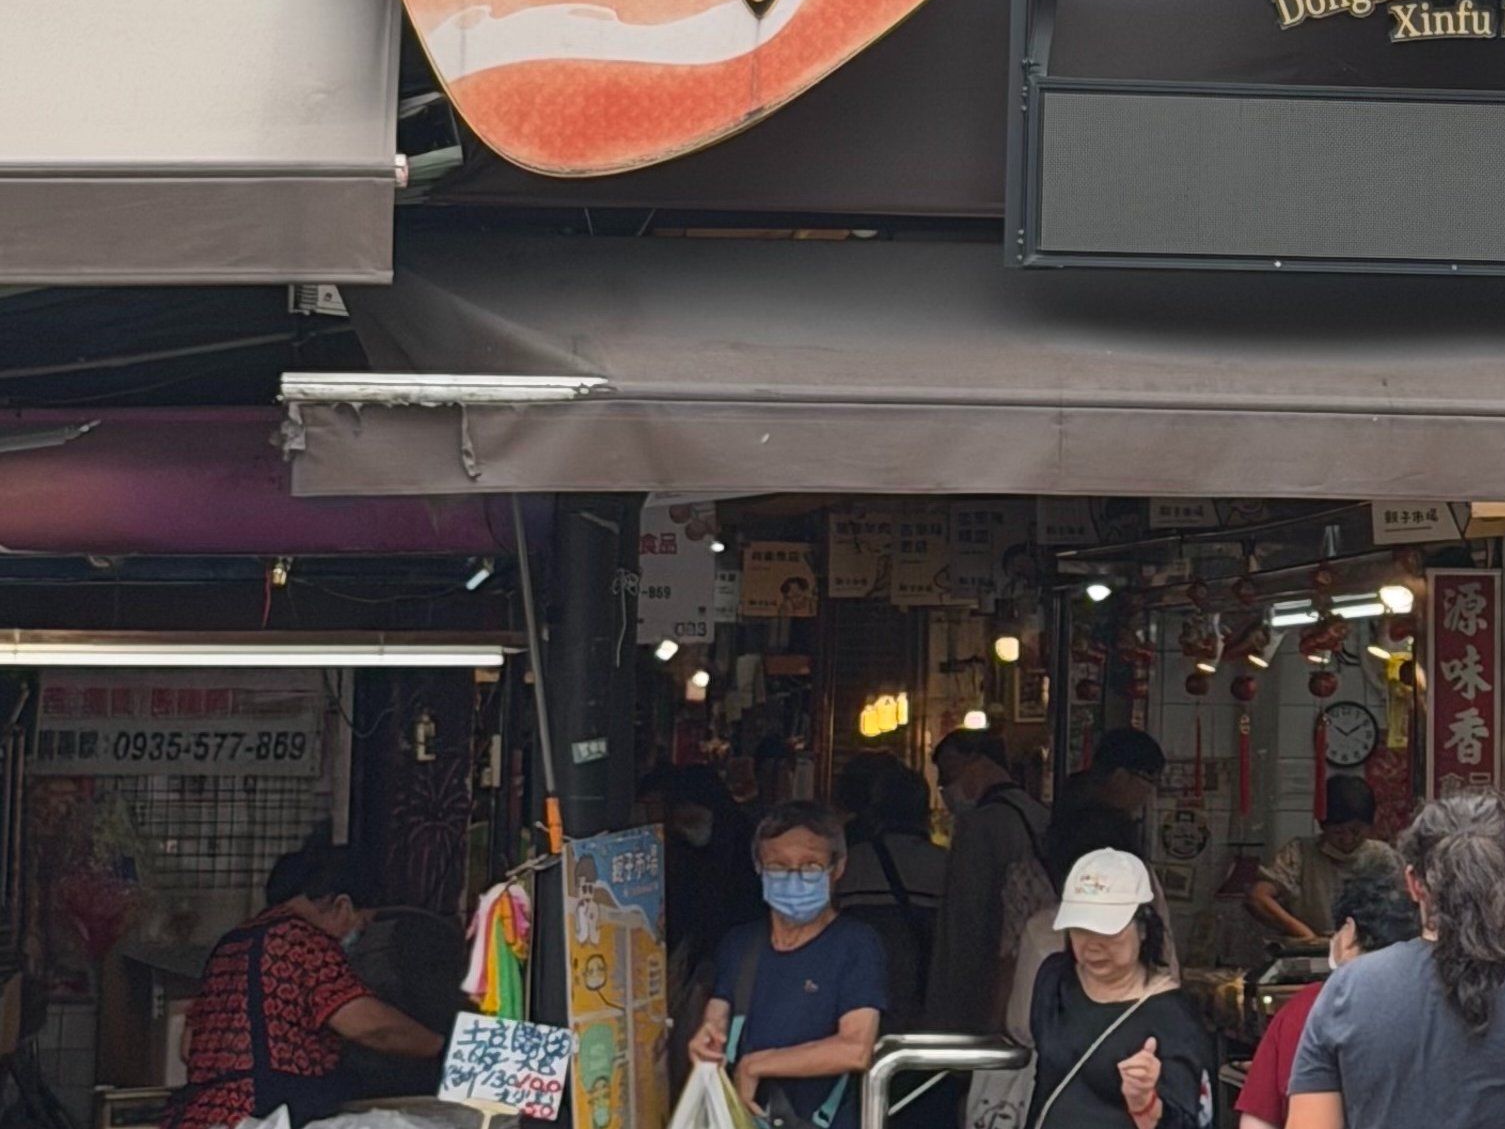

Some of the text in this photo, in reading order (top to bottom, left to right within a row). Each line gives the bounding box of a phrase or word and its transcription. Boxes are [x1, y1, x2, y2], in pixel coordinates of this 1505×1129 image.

[1390, 0, 1492, 40] Xinfu
[1440, 582, 1492, 765] 源味香
[113, 730, 307, 762] 0935-577-869
